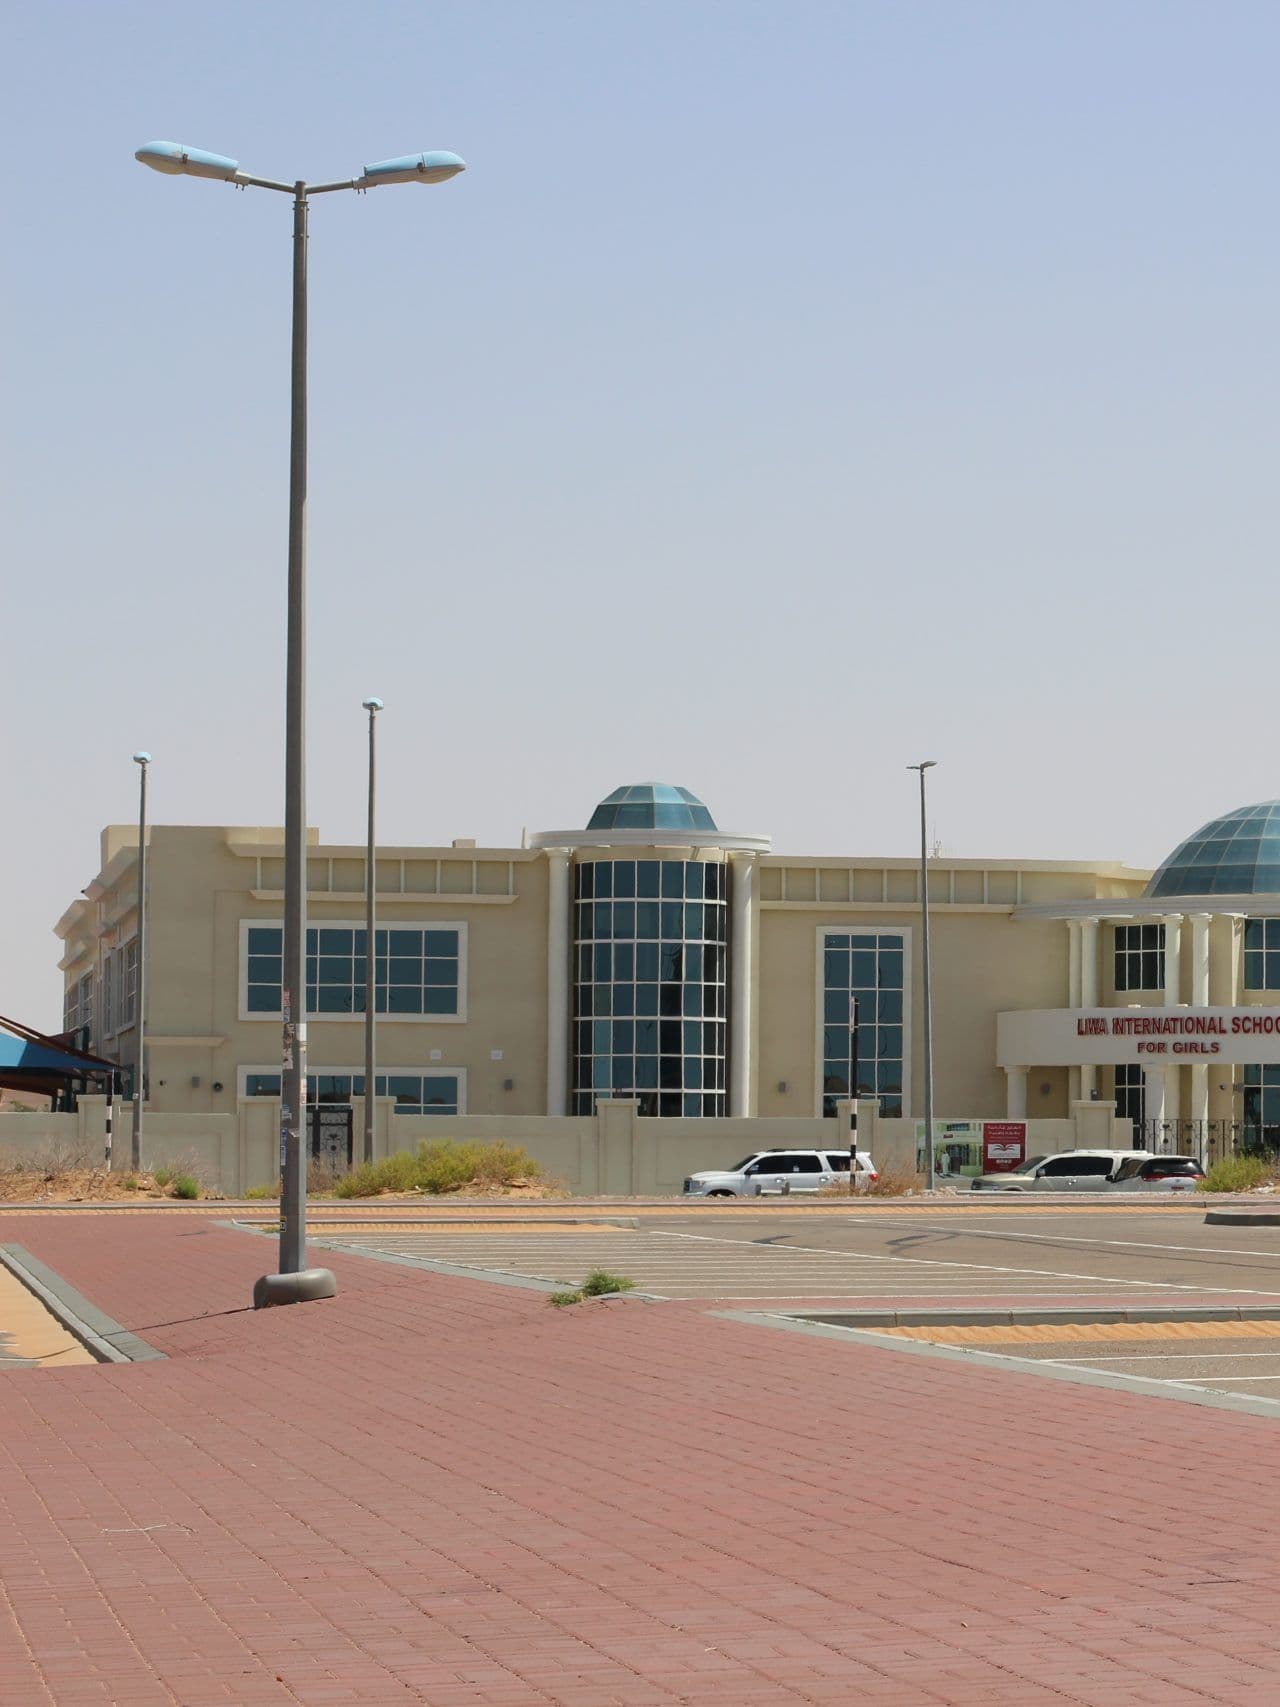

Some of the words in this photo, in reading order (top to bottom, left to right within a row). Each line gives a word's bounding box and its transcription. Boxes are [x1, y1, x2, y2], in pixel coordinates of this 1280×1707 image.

[1077, 1018, 1107, 1035] LIWA
[1112, 1017, 1226, 1035] INTERNATIONAL
[1137, 1042, 1167, 1053] FOR
[1173, 1042, 1220, 1053] GIRLS
